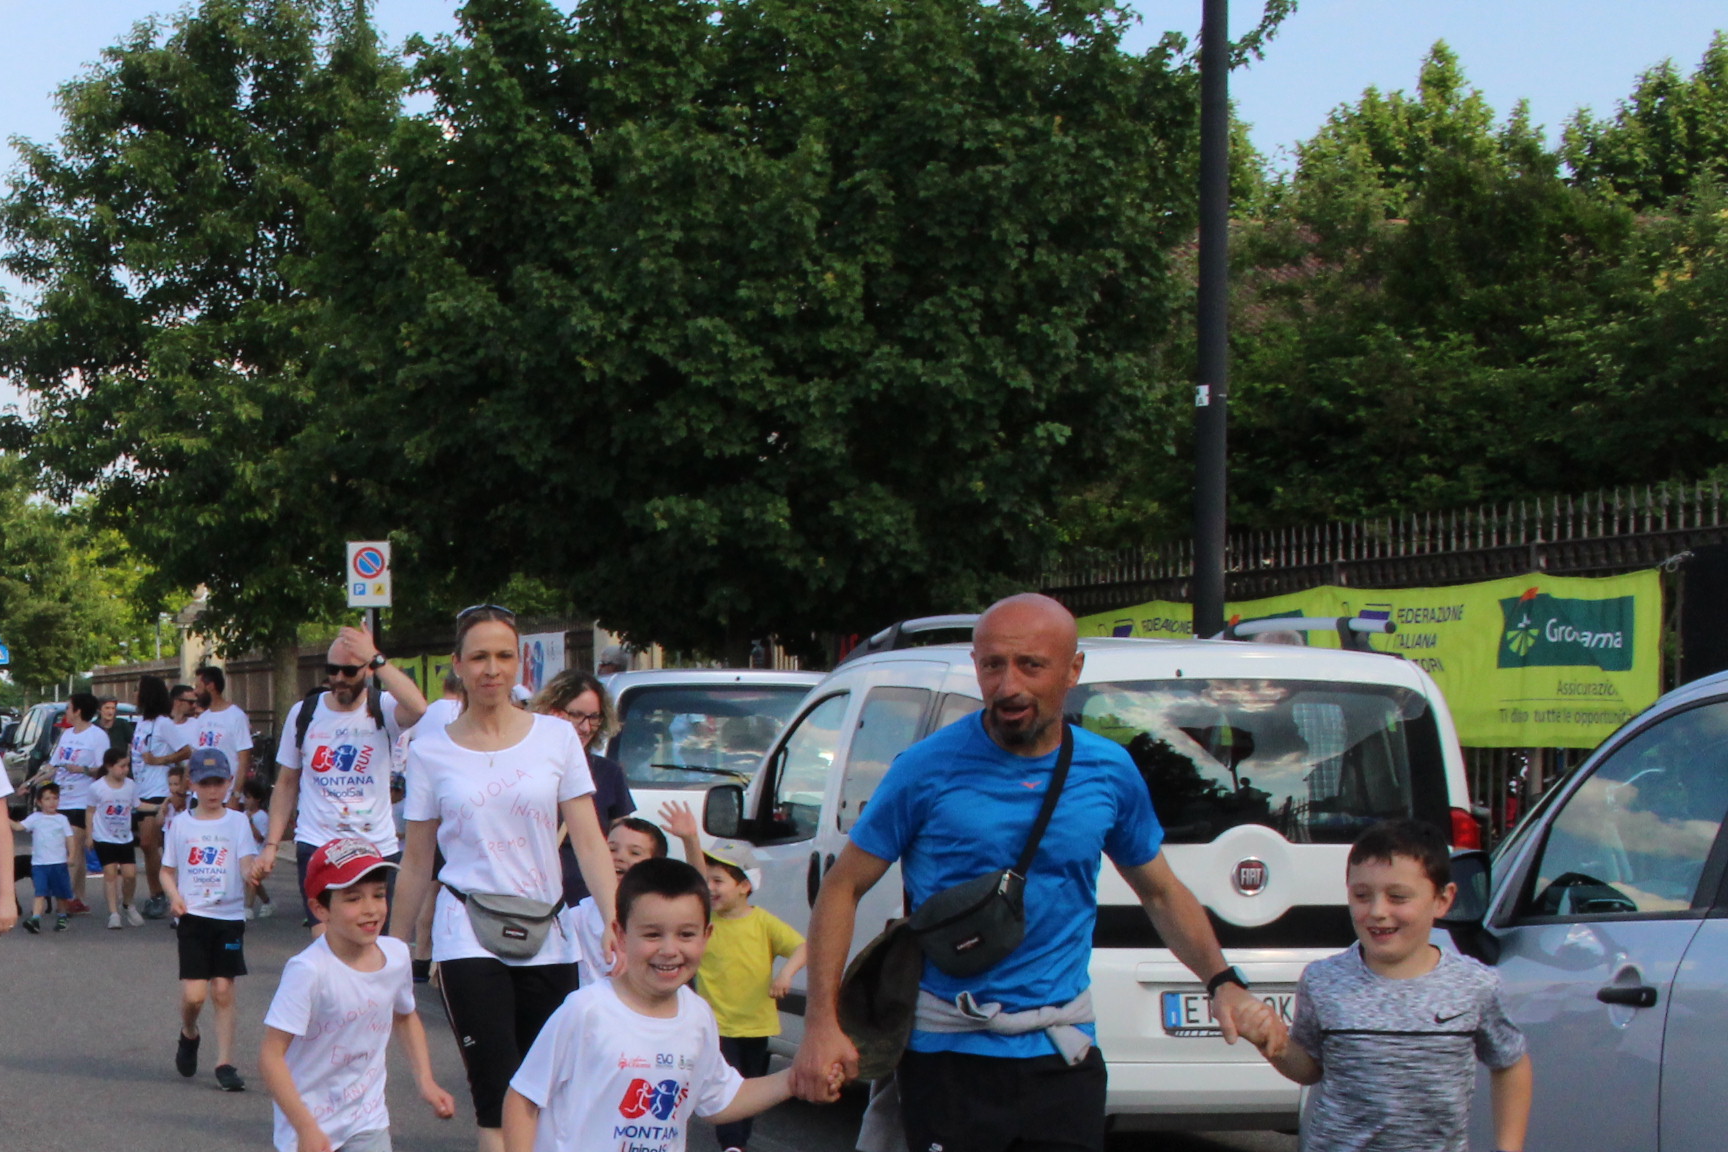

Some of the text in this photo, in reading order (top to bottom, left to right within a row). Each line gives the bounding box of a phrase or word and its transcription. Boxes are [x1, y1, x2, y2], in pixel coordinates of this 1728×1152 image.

[353, 745, 374, 773] RUN
[312, 776, 374, 786] MONTANA
[1240, 868, 1262, 886] FIAT
[656, 1053, 674, 1065] EVO
